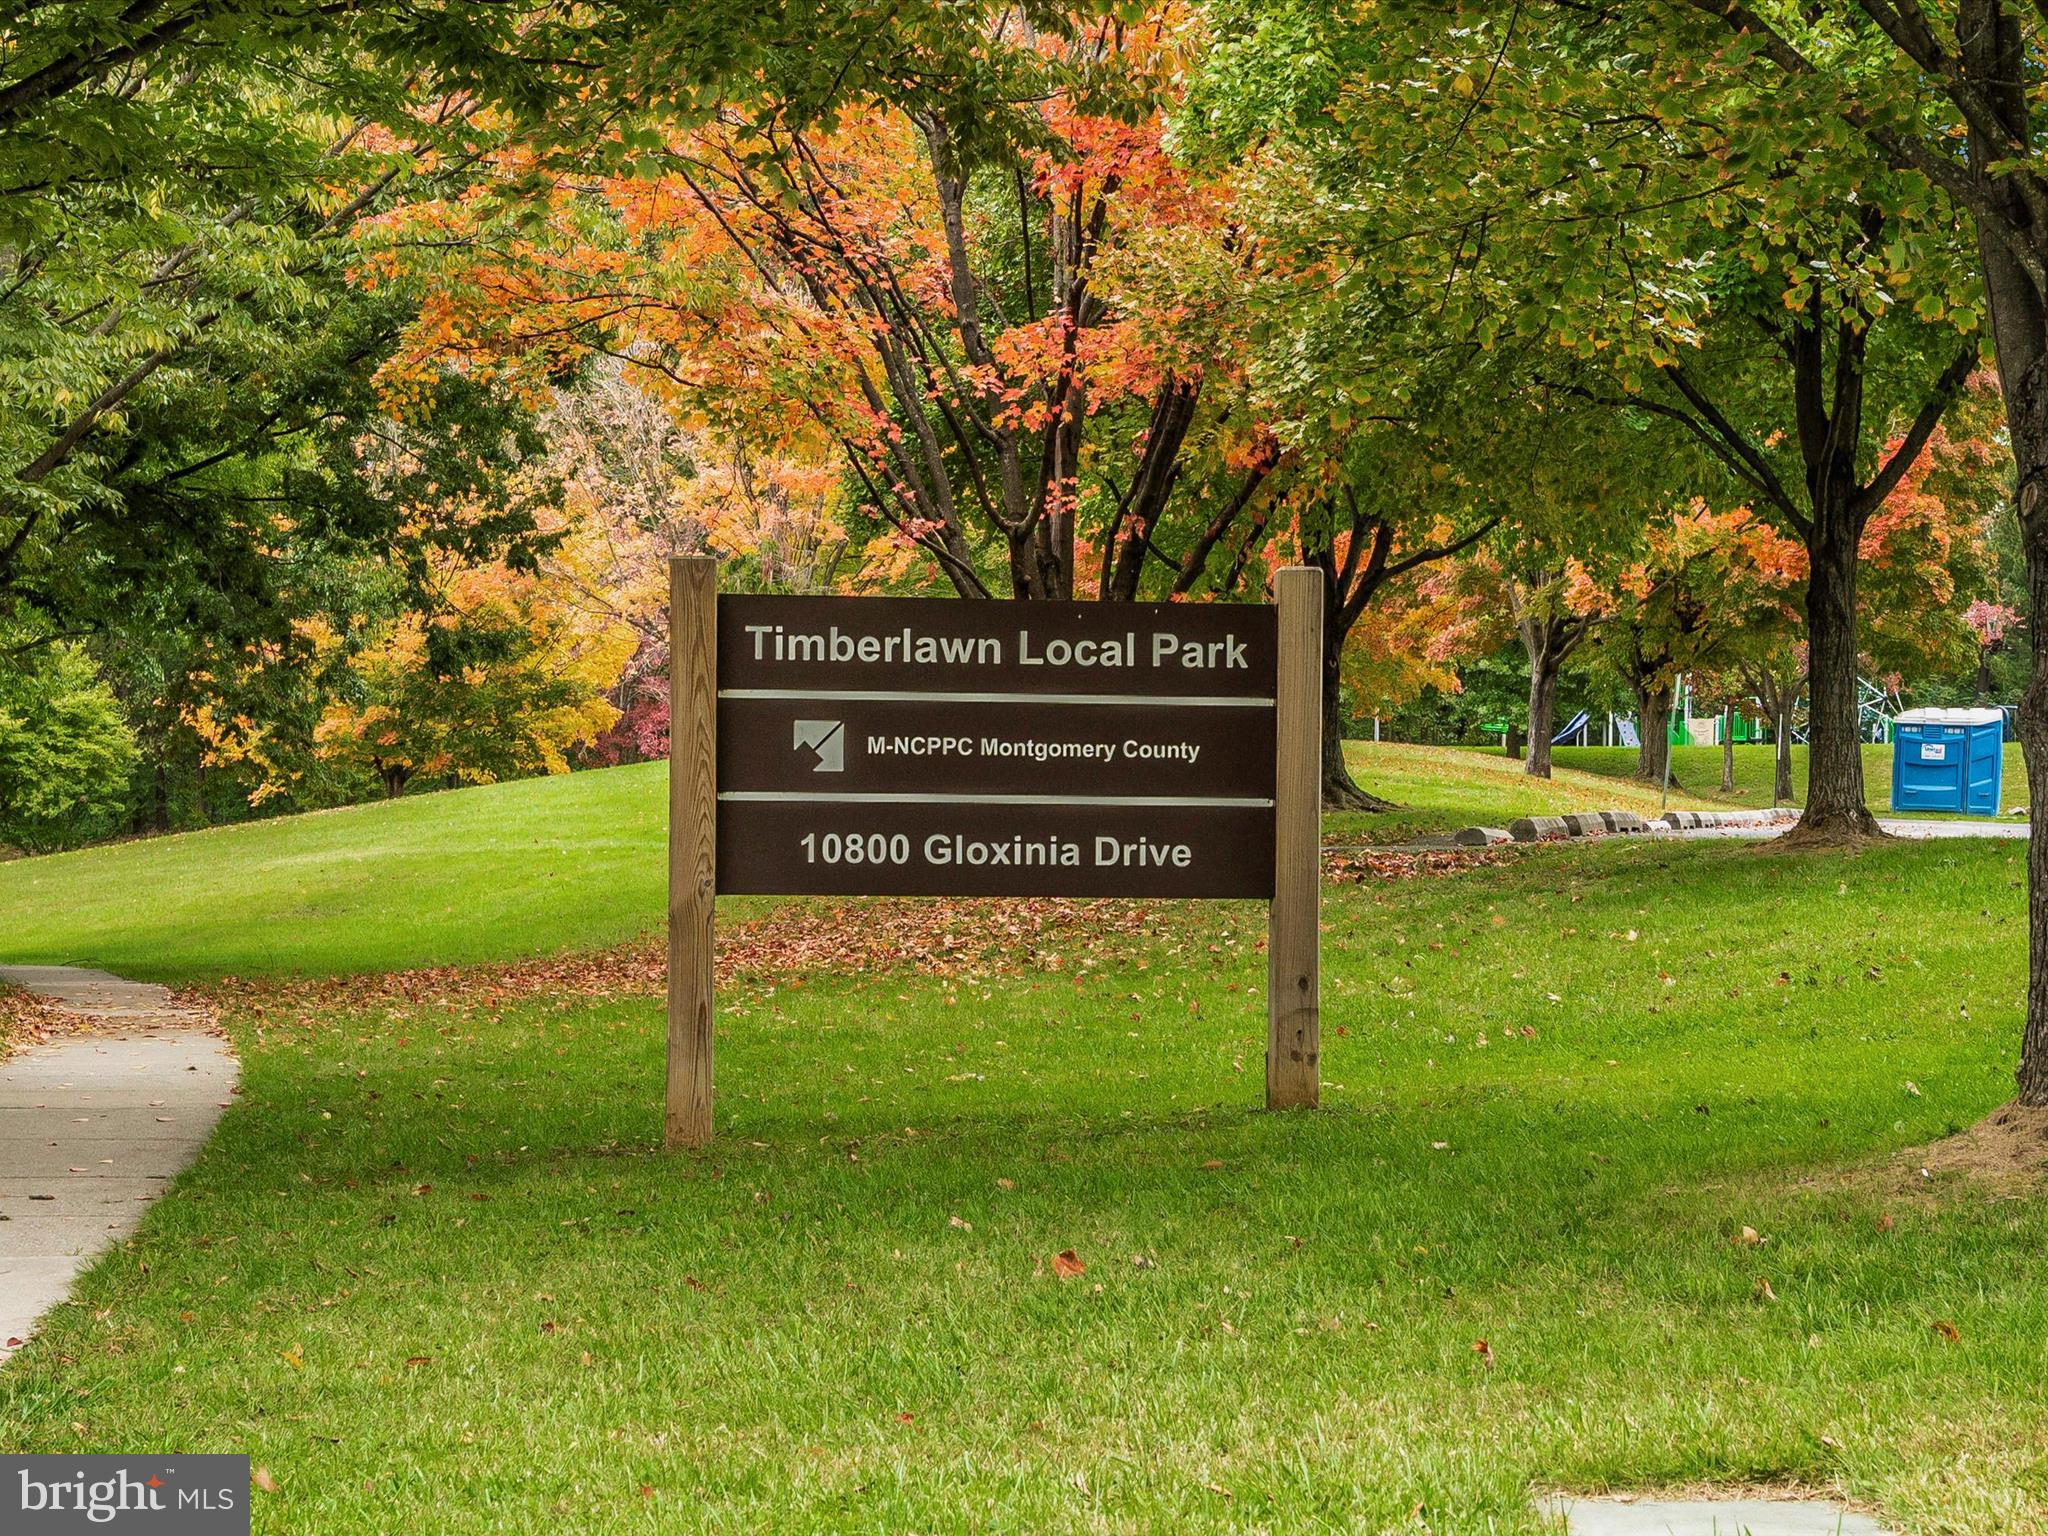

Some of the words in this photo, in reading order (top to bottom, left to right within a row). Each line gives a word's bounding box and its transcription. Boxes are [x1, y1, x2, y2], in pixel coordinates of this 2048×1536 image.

[744, 625, 1001, 665] Timberlawn
[1019, 631, 1135, 667] Local
[1152, 633, 1249, 669] Park
[867, 736, 973, 757] M-NCPPC
[980, 738, 1116, 763] Montgomery
[1122, 739, 1201, 764] County
[800, 833, 910, 865] 10800
[924, 834, 1080, 866] Gloxinia
[1095, 836, 1192, 868] Drive
